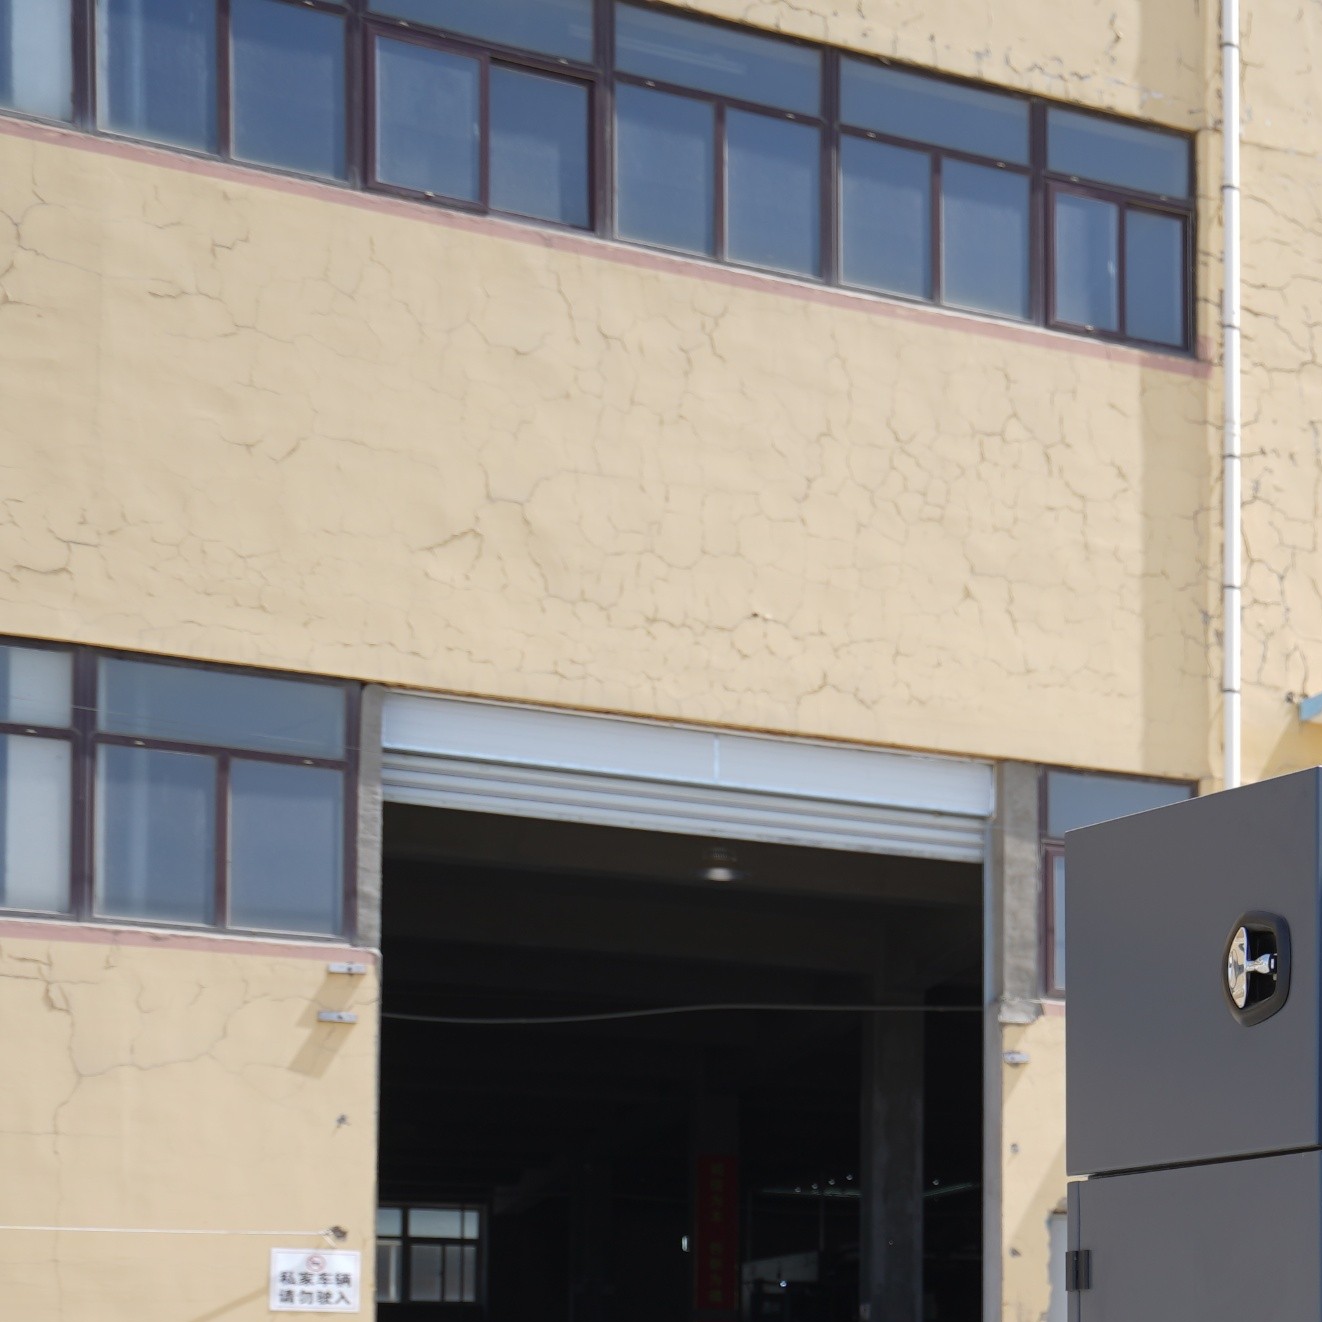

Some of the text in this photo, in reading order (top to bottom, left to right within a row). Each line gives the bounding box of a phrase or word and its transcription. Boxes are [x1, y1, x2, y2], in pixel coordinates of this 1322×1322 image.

[279, 1270, 352, 1288] 私家车辆
[279, 1289, 351, 1305] 请勿驶入
